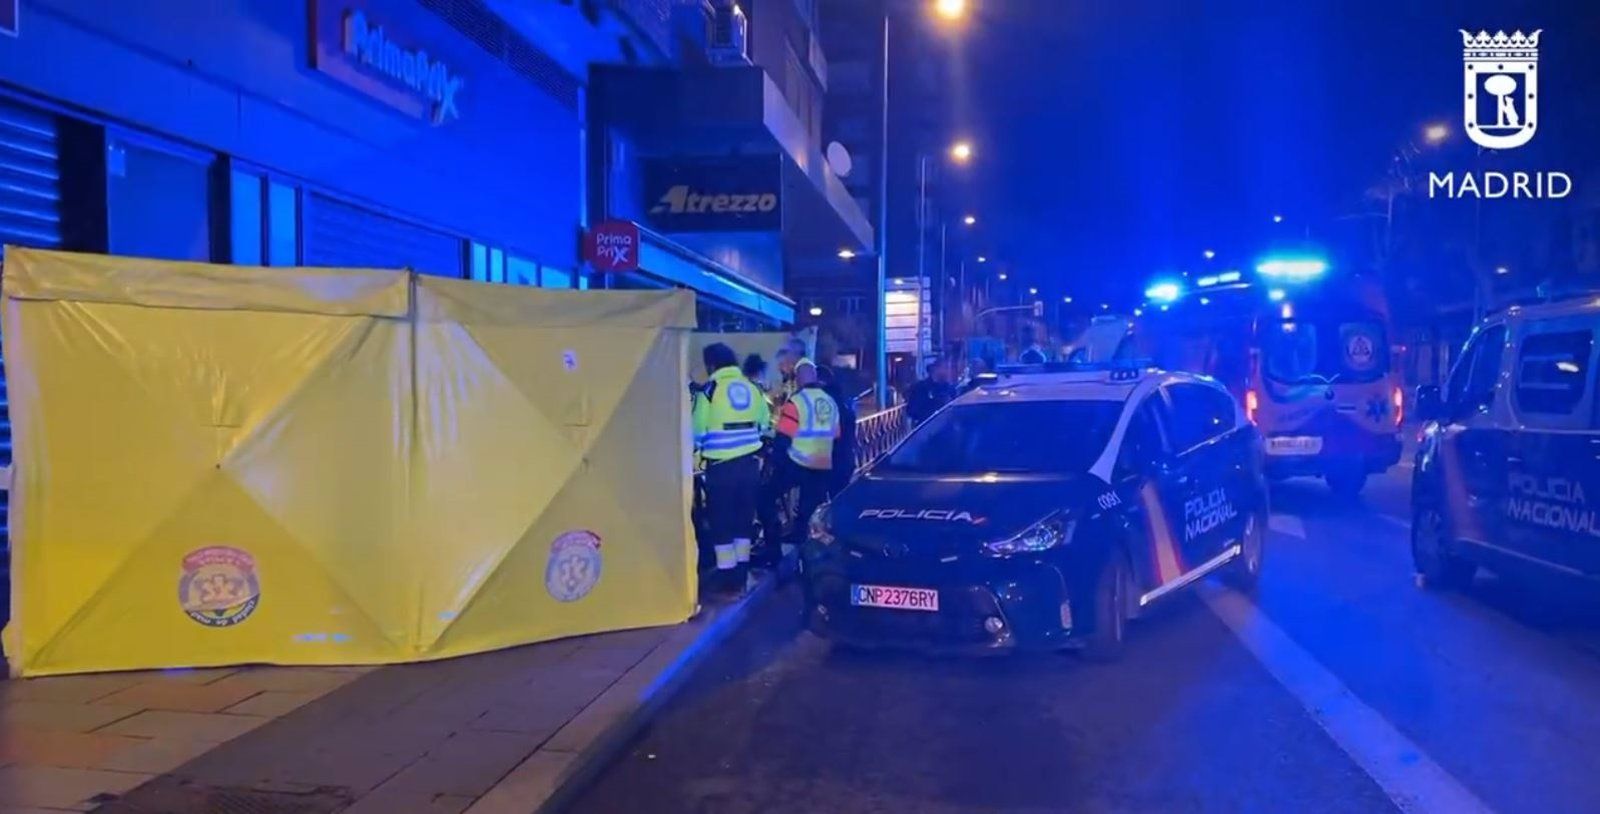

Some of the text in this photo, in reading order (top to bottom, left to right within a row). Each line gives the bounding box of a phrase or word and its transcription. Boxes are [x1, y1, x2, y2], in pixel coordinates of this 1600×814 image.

[650, 184, 777, 214] Atrezzo
[596, 232, 632, 246] Prima
[1185, 502, 1238, 543] NACIONAL
[1506, 497, 1600, 537] NACIONAL
